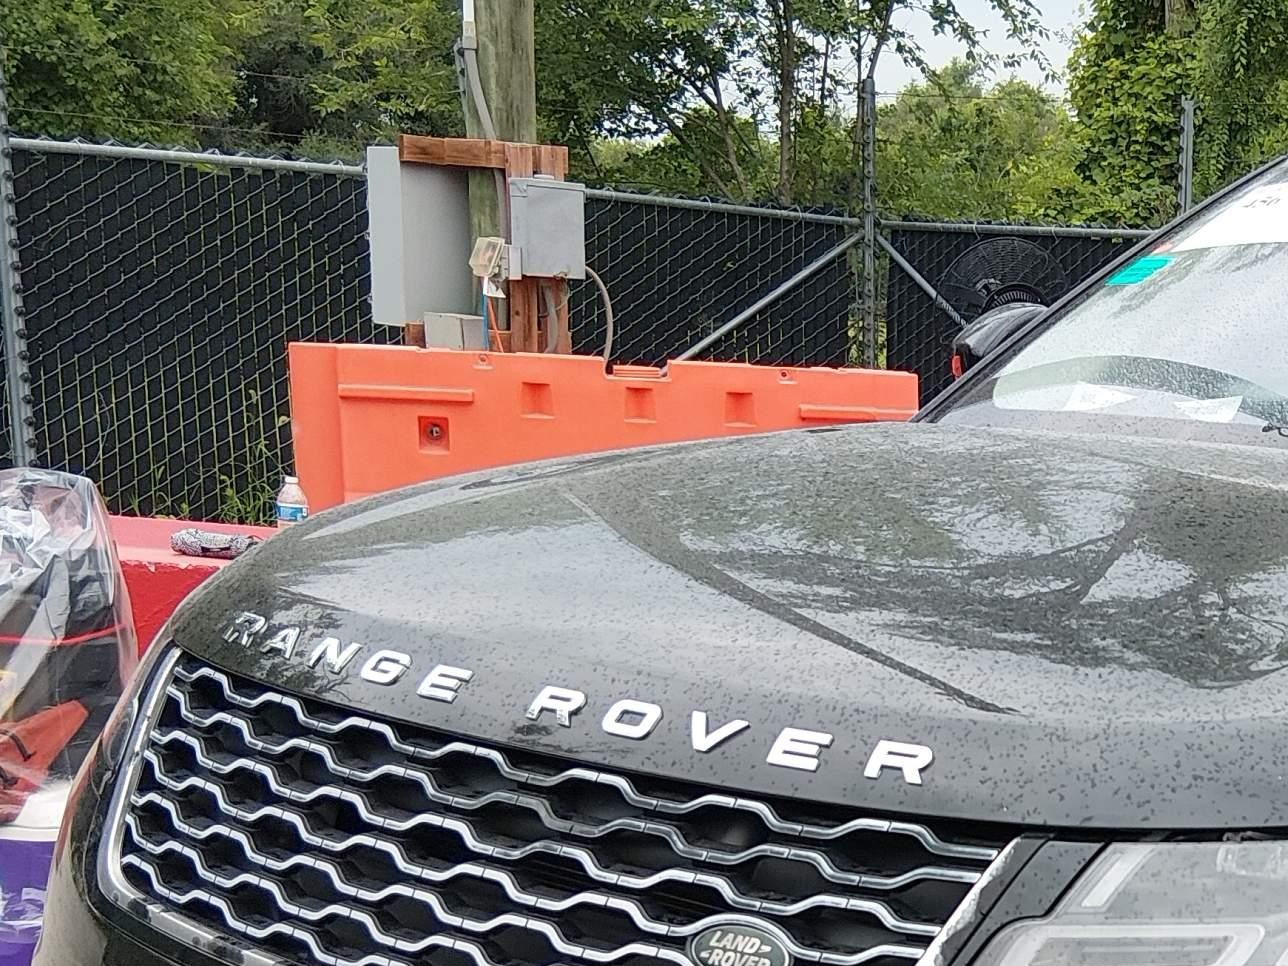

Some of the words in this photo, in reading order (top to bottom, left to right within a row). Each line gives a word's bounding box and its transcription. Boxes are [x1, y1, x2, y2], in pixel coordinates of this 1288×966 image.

[224, 611, 474, 704] RANGE
[525, 684, 936, 786] ROVER
[709, 930, 761, 954] LAND
